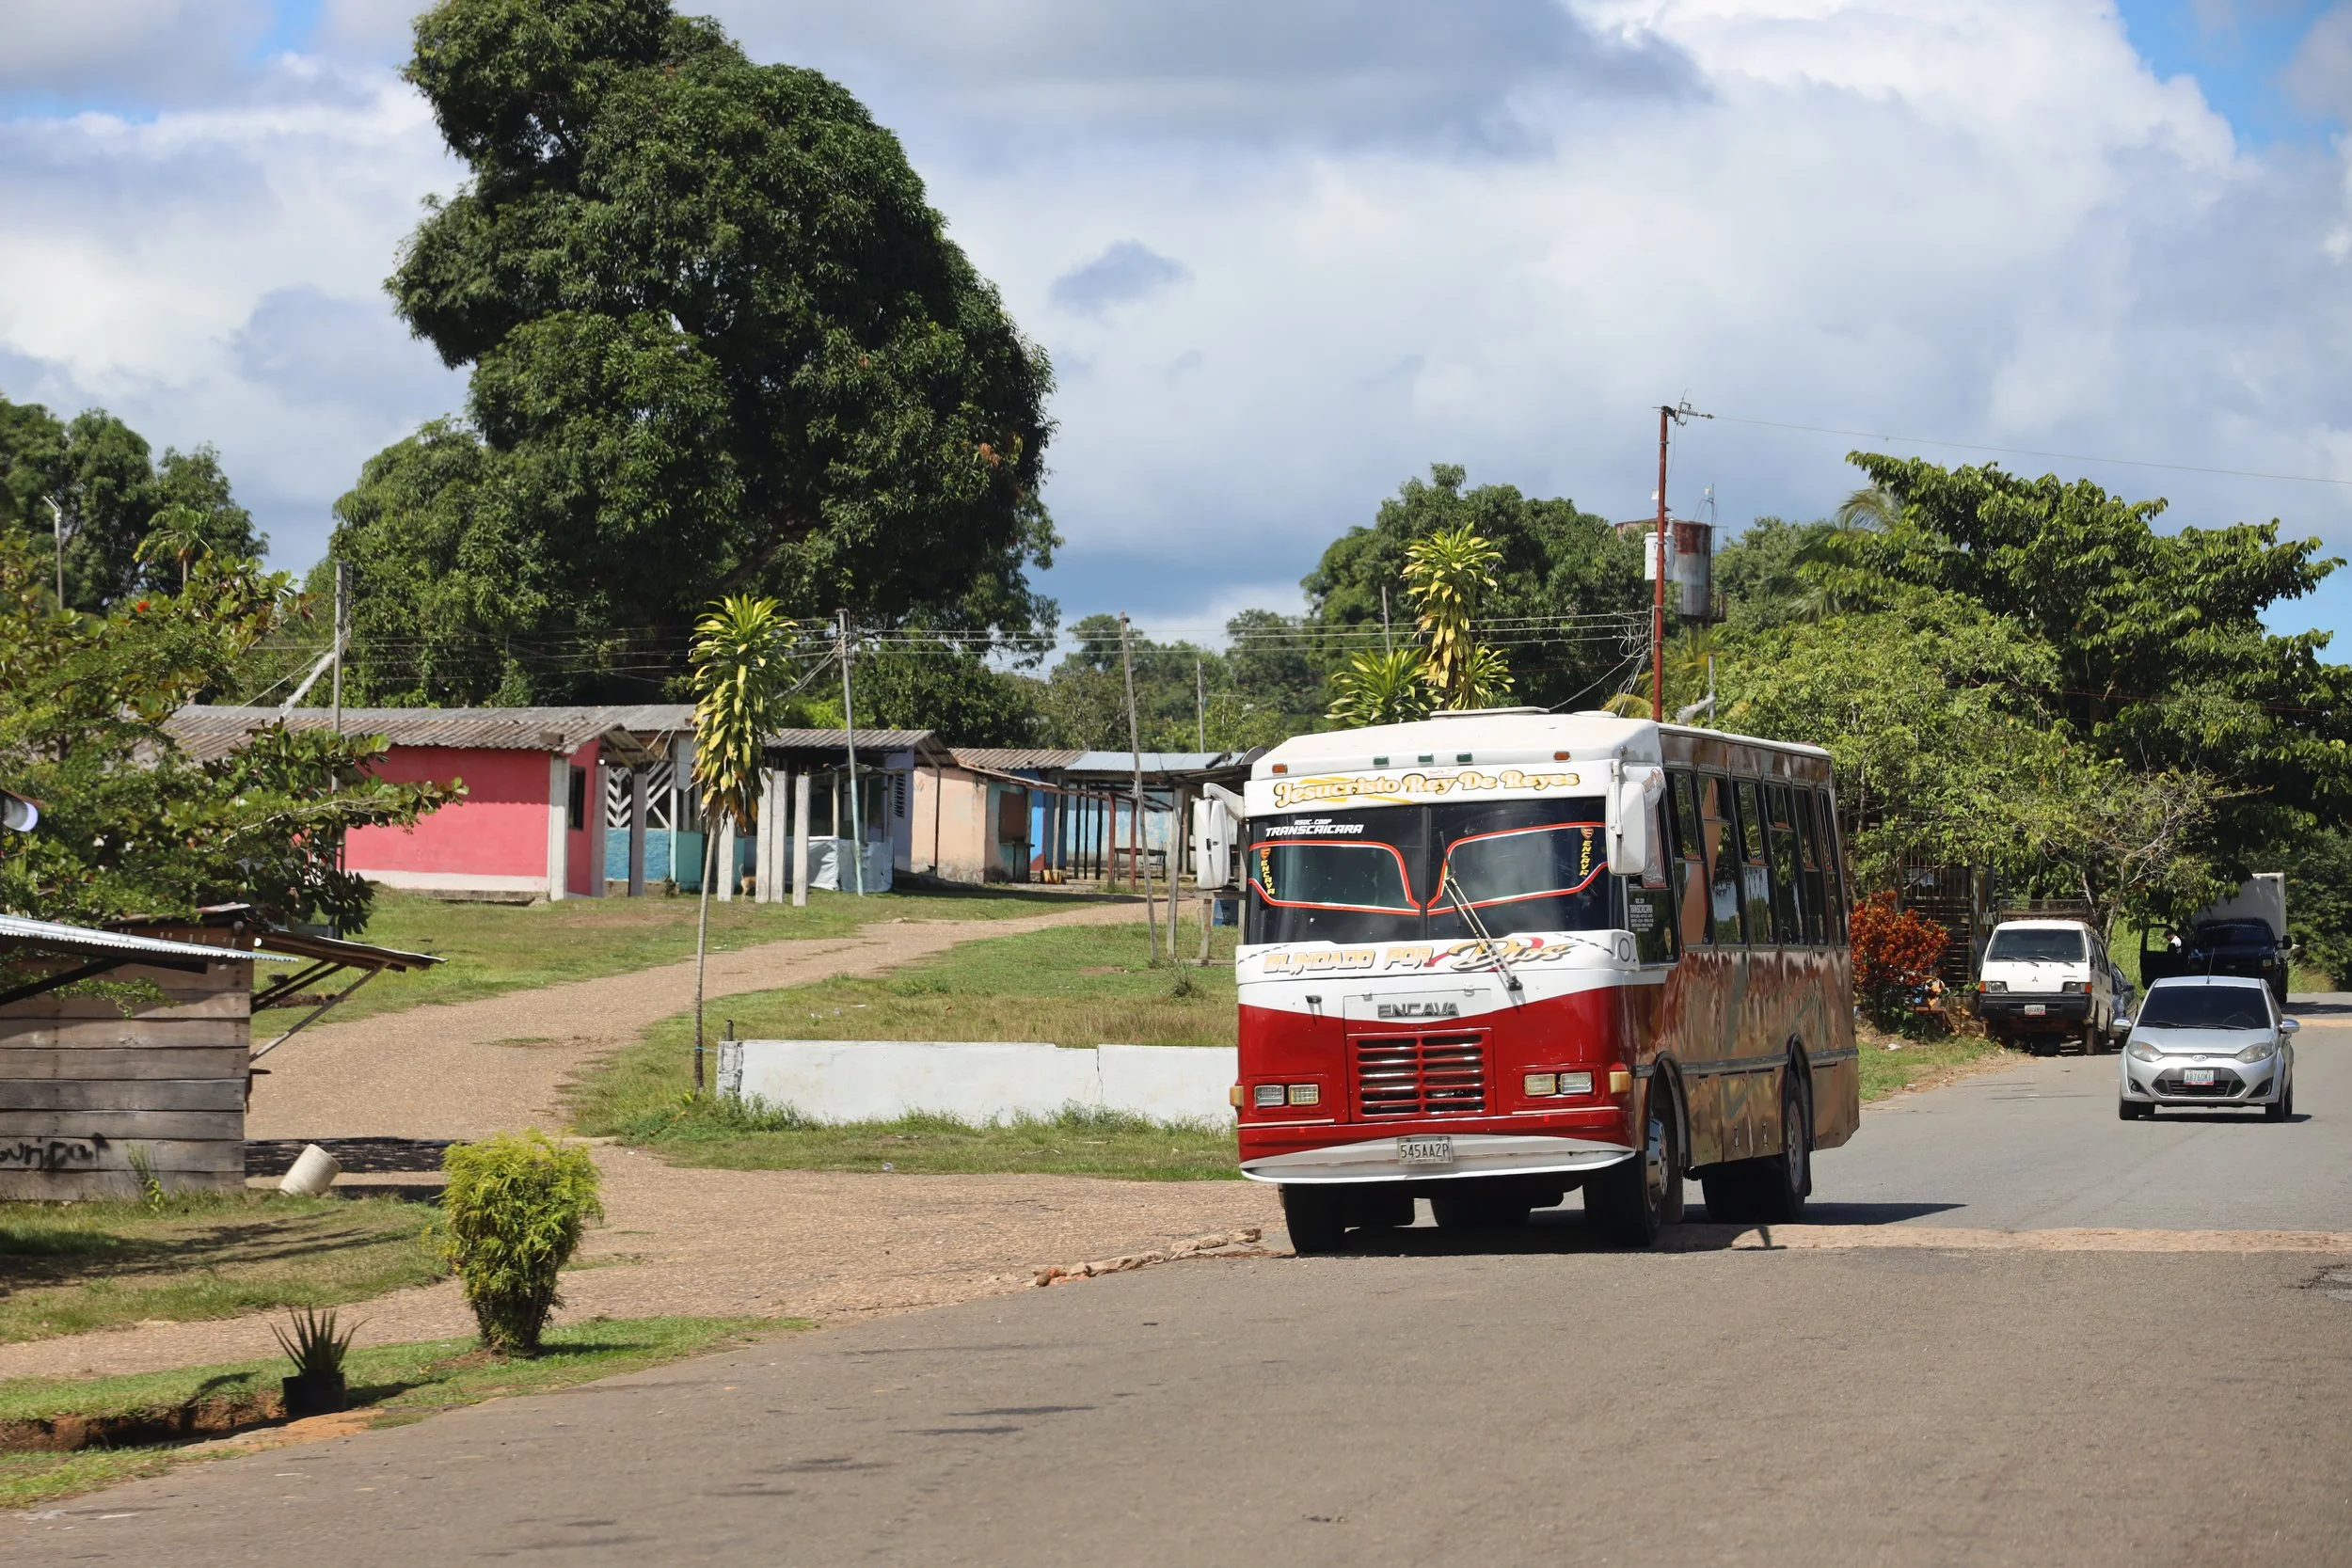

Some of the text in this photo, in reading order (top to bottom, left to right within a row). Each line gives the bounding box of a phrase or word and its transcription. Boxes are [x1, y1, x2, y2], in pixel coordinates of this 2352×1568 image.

[1274, 769, 1581, 809] Jesucristo Rey De Reyes
[1265, 824, 1364, 837] TRANSCAICARA
[1580, 840, 1593, 877] ENCAVA
[1261, 860, 1276, 895] ENCAVA
[1383, 945, 1434, 970] POR
[1377, 1002, 1460, 1019] ENCAVA
[1400, 1143, 1449, 1158] 545AA2P
